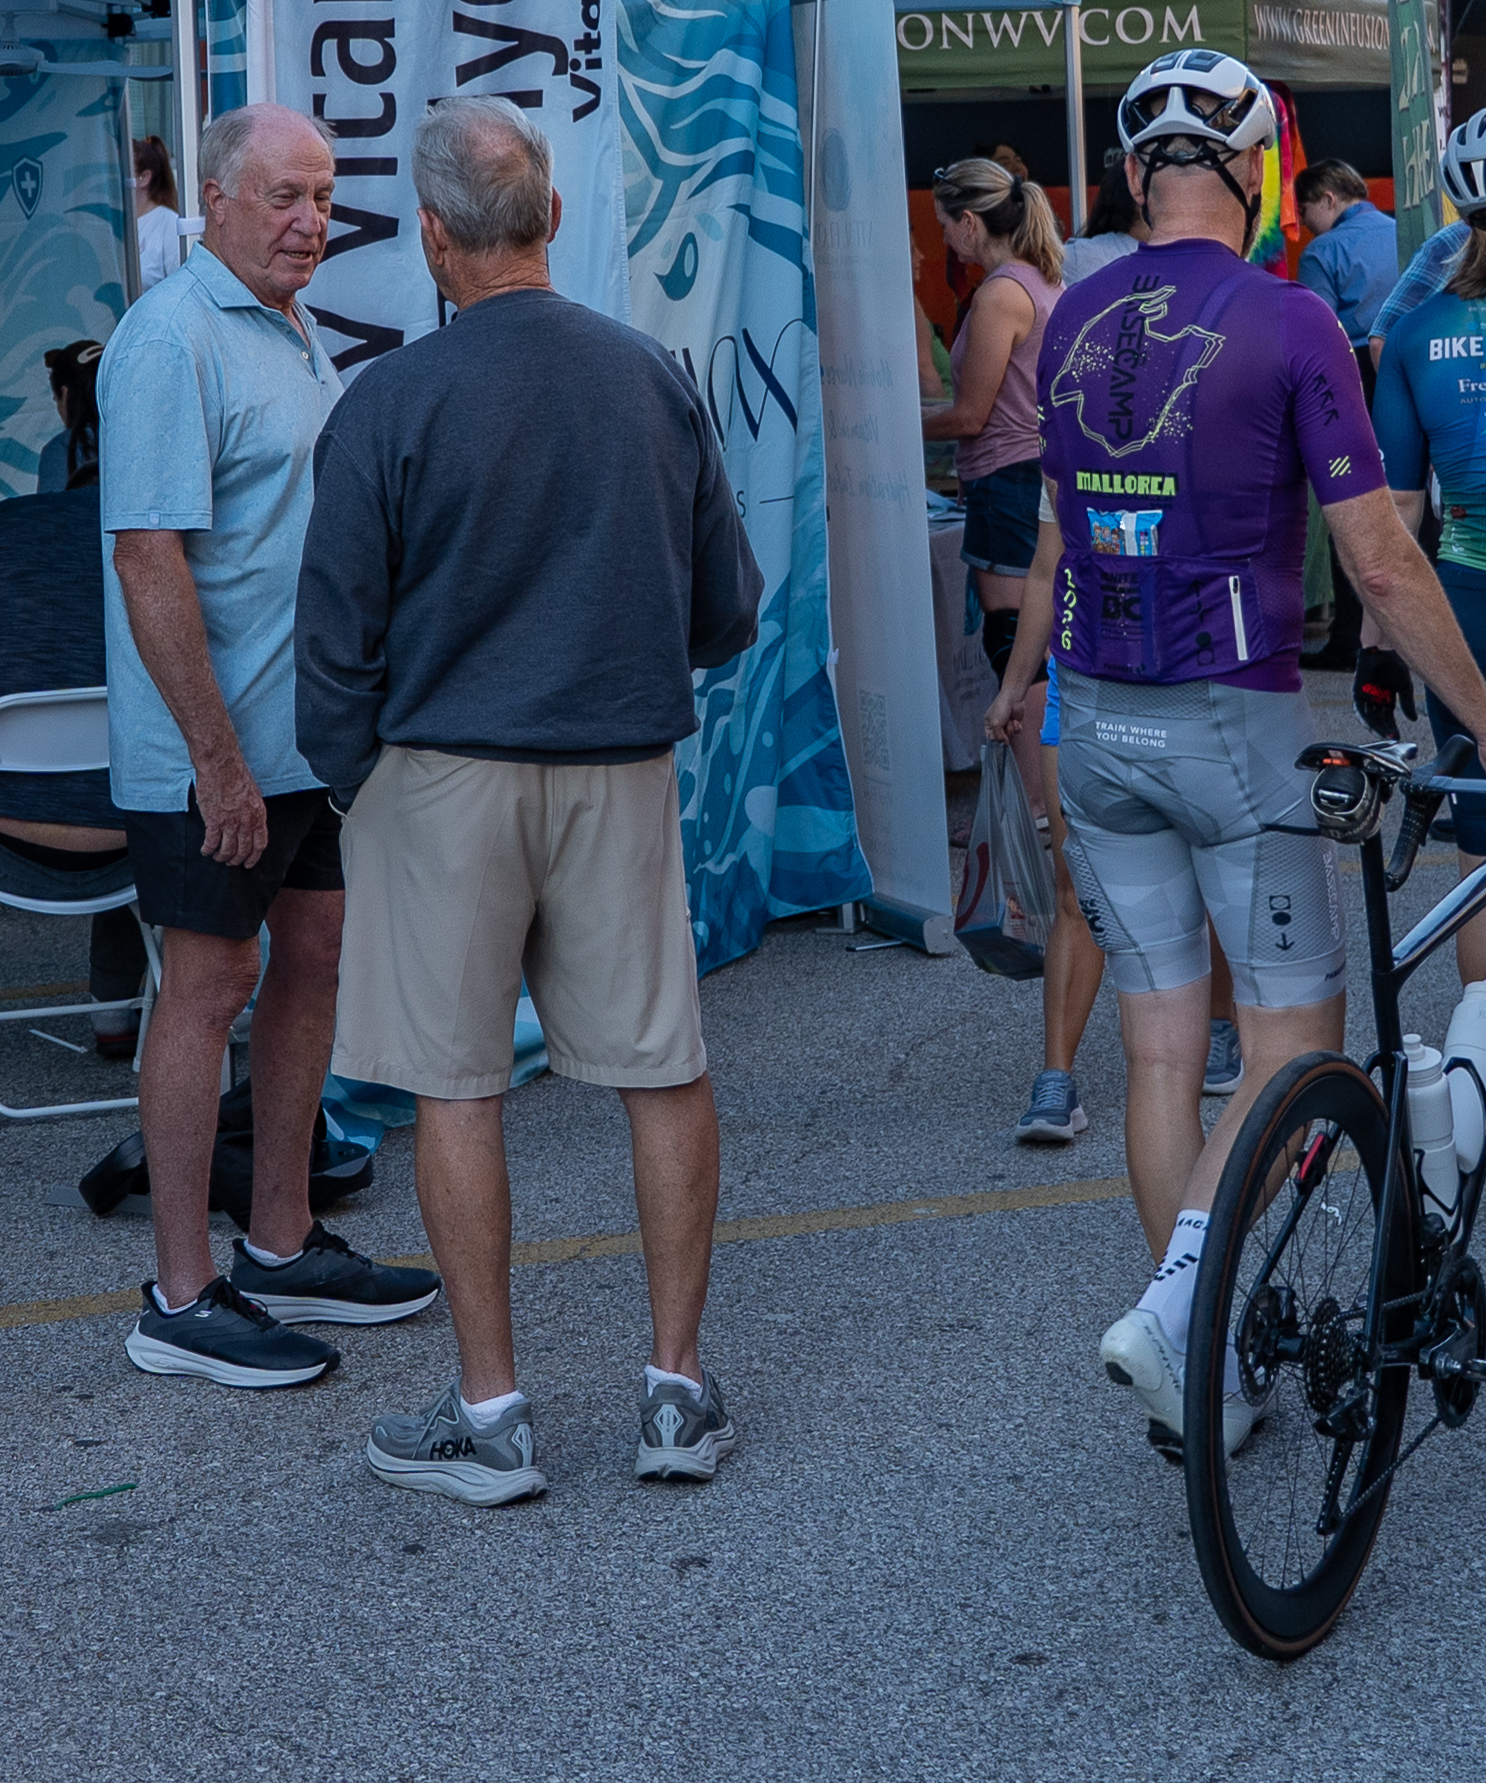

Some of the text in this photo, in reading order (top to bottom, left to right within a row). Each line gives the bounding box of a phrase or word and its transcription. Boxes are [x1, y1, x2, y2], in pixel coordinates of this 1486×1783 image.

[1429, 335, 1484, 362] BIKE
[1095, 721, 1167, 739] TRAIN WHERE
[1096, 731, 1166, 749] YOU BELONG
[429, 1436, 477, 1461] HOKA
